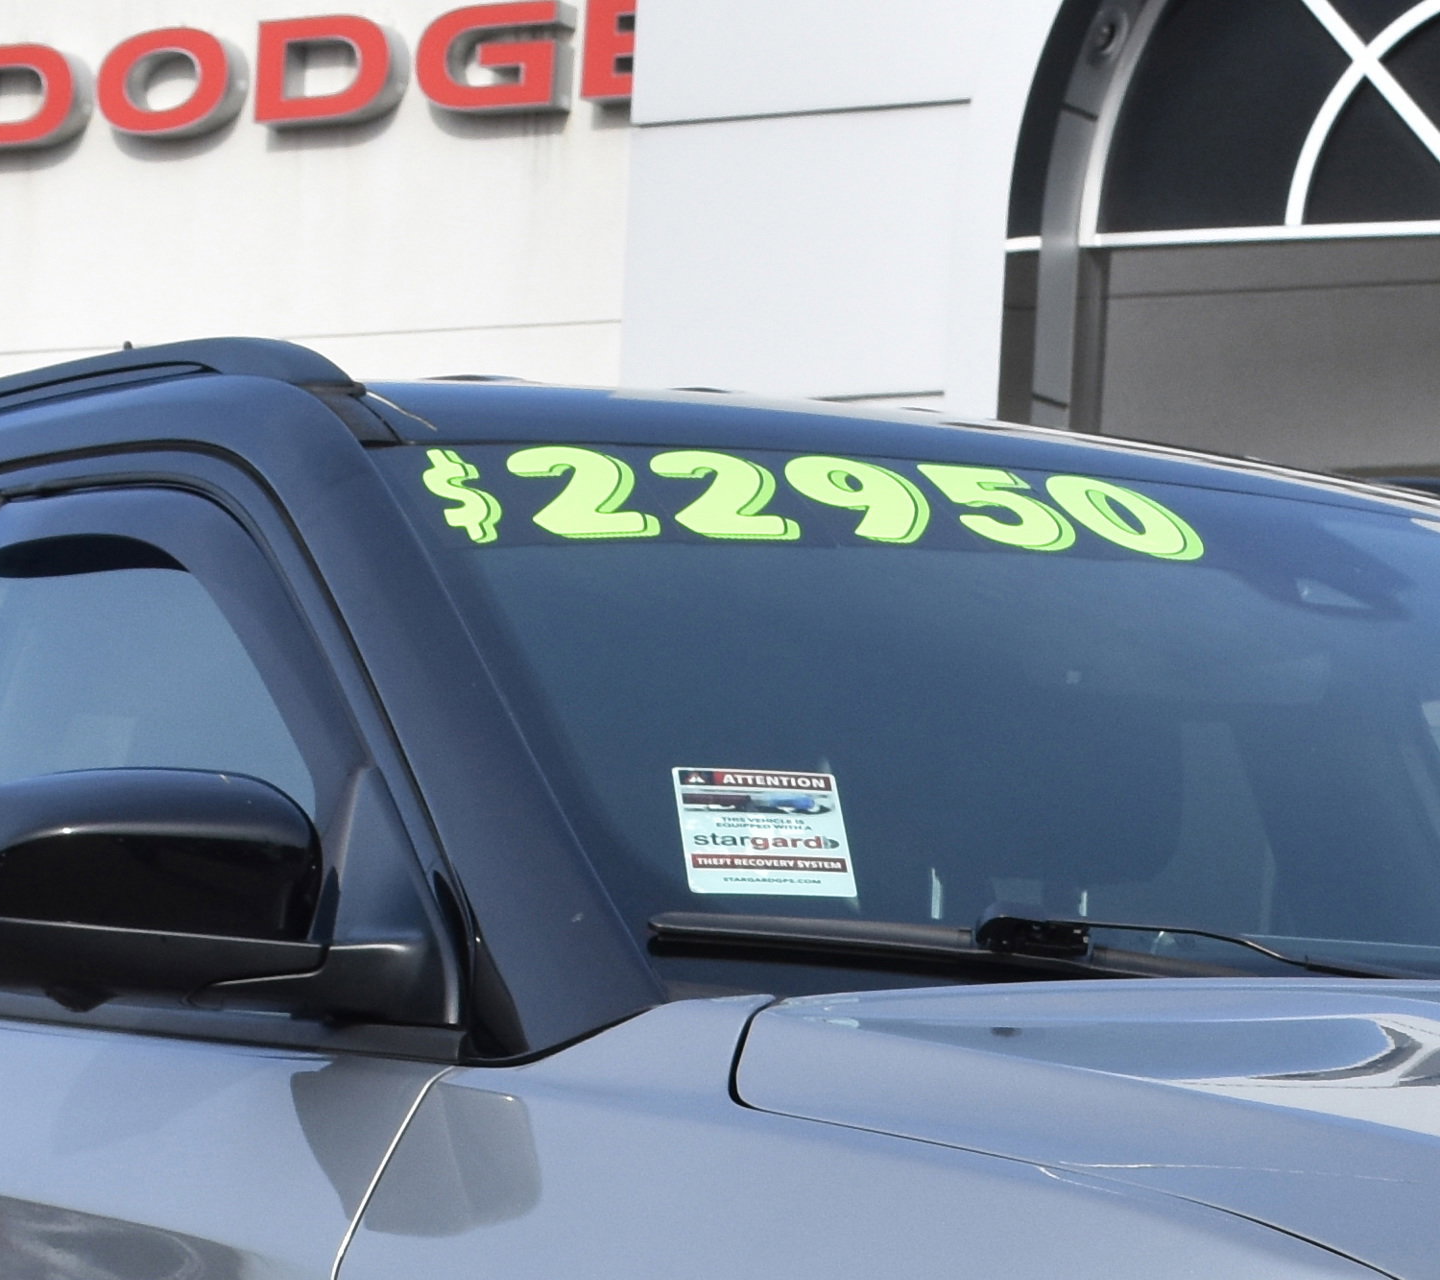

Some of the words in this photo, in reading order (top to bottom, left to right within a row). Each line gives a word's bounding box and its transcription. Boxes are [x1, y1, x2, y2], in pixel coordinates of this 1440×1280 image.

[422, 445, 1205, 561] $22950
[722, 773, 826, 789] ATTENTION
[696, 857, 732, 866] THEFT
[733, 858, 795, 868] RECOVERY
[796, 860, 842, 870] SYSTEM
